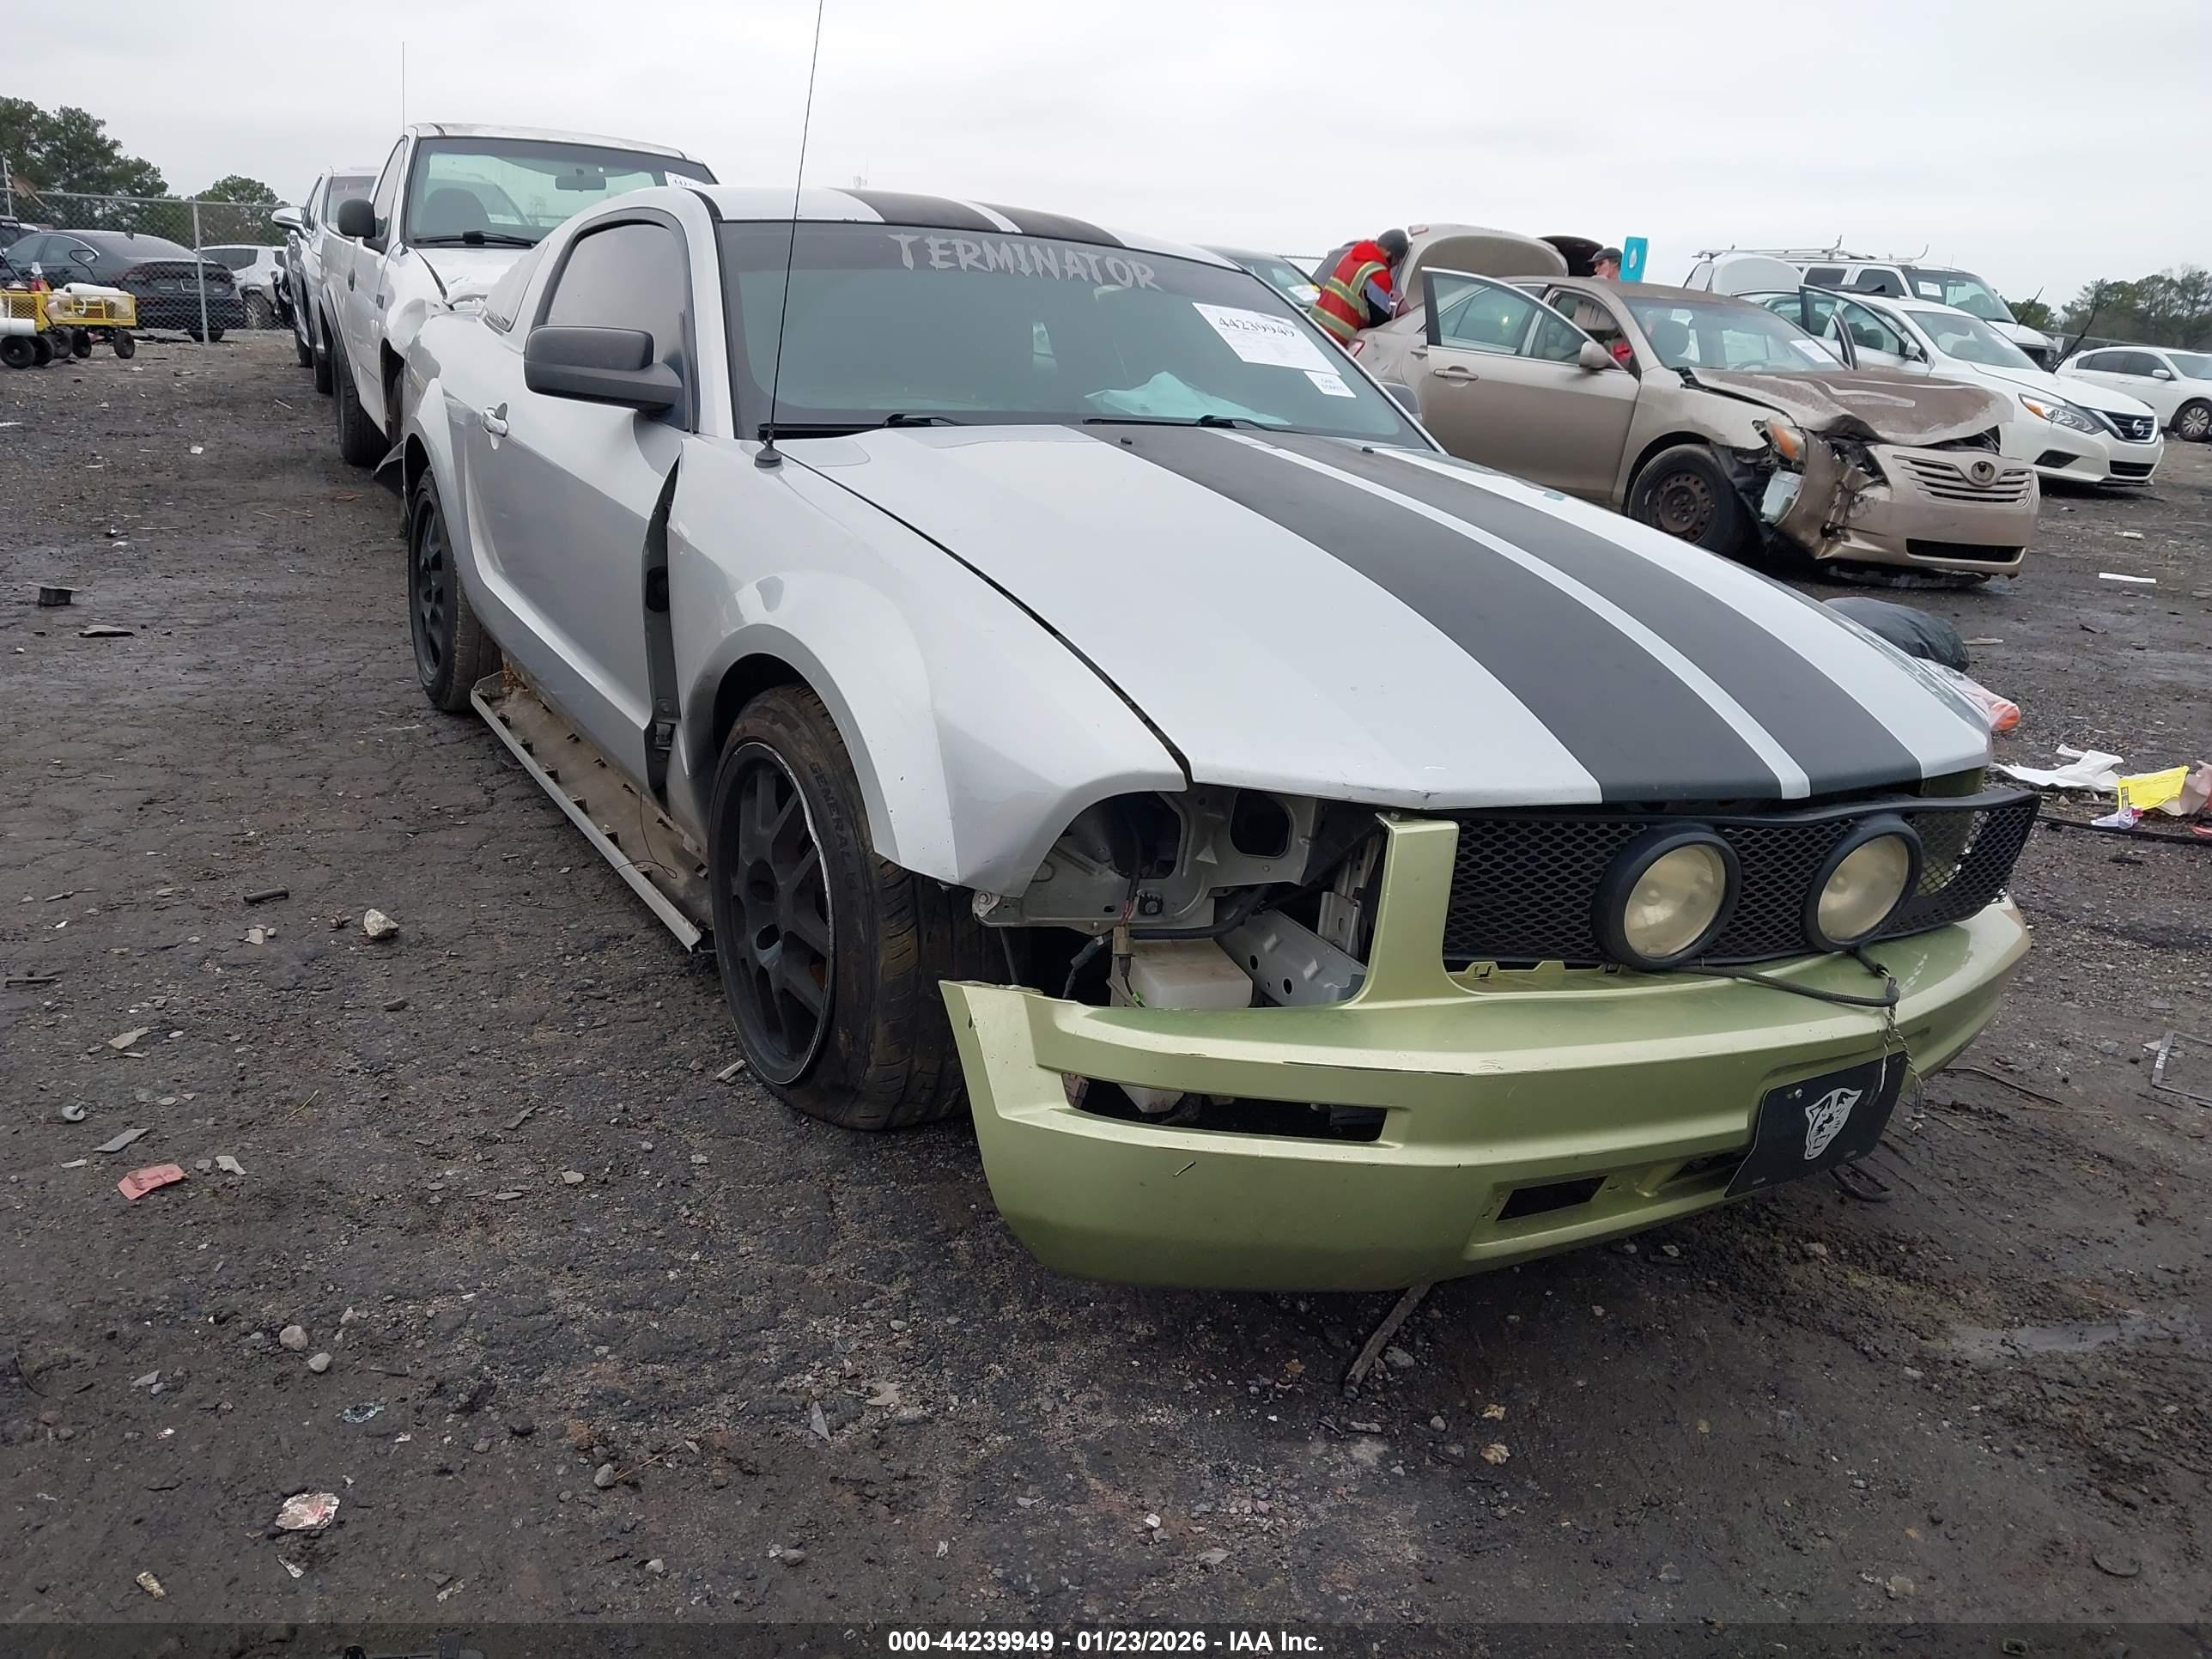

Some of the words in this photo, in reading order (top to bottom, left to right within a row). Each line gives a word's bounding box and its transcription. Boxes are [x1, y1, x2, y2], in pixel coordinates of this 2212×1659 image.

[888, 233, 1167, 301] TERMINATOR
[1218, 316, 1296, 337] 44239949
[809, 762, 851, 859] GENERAL
